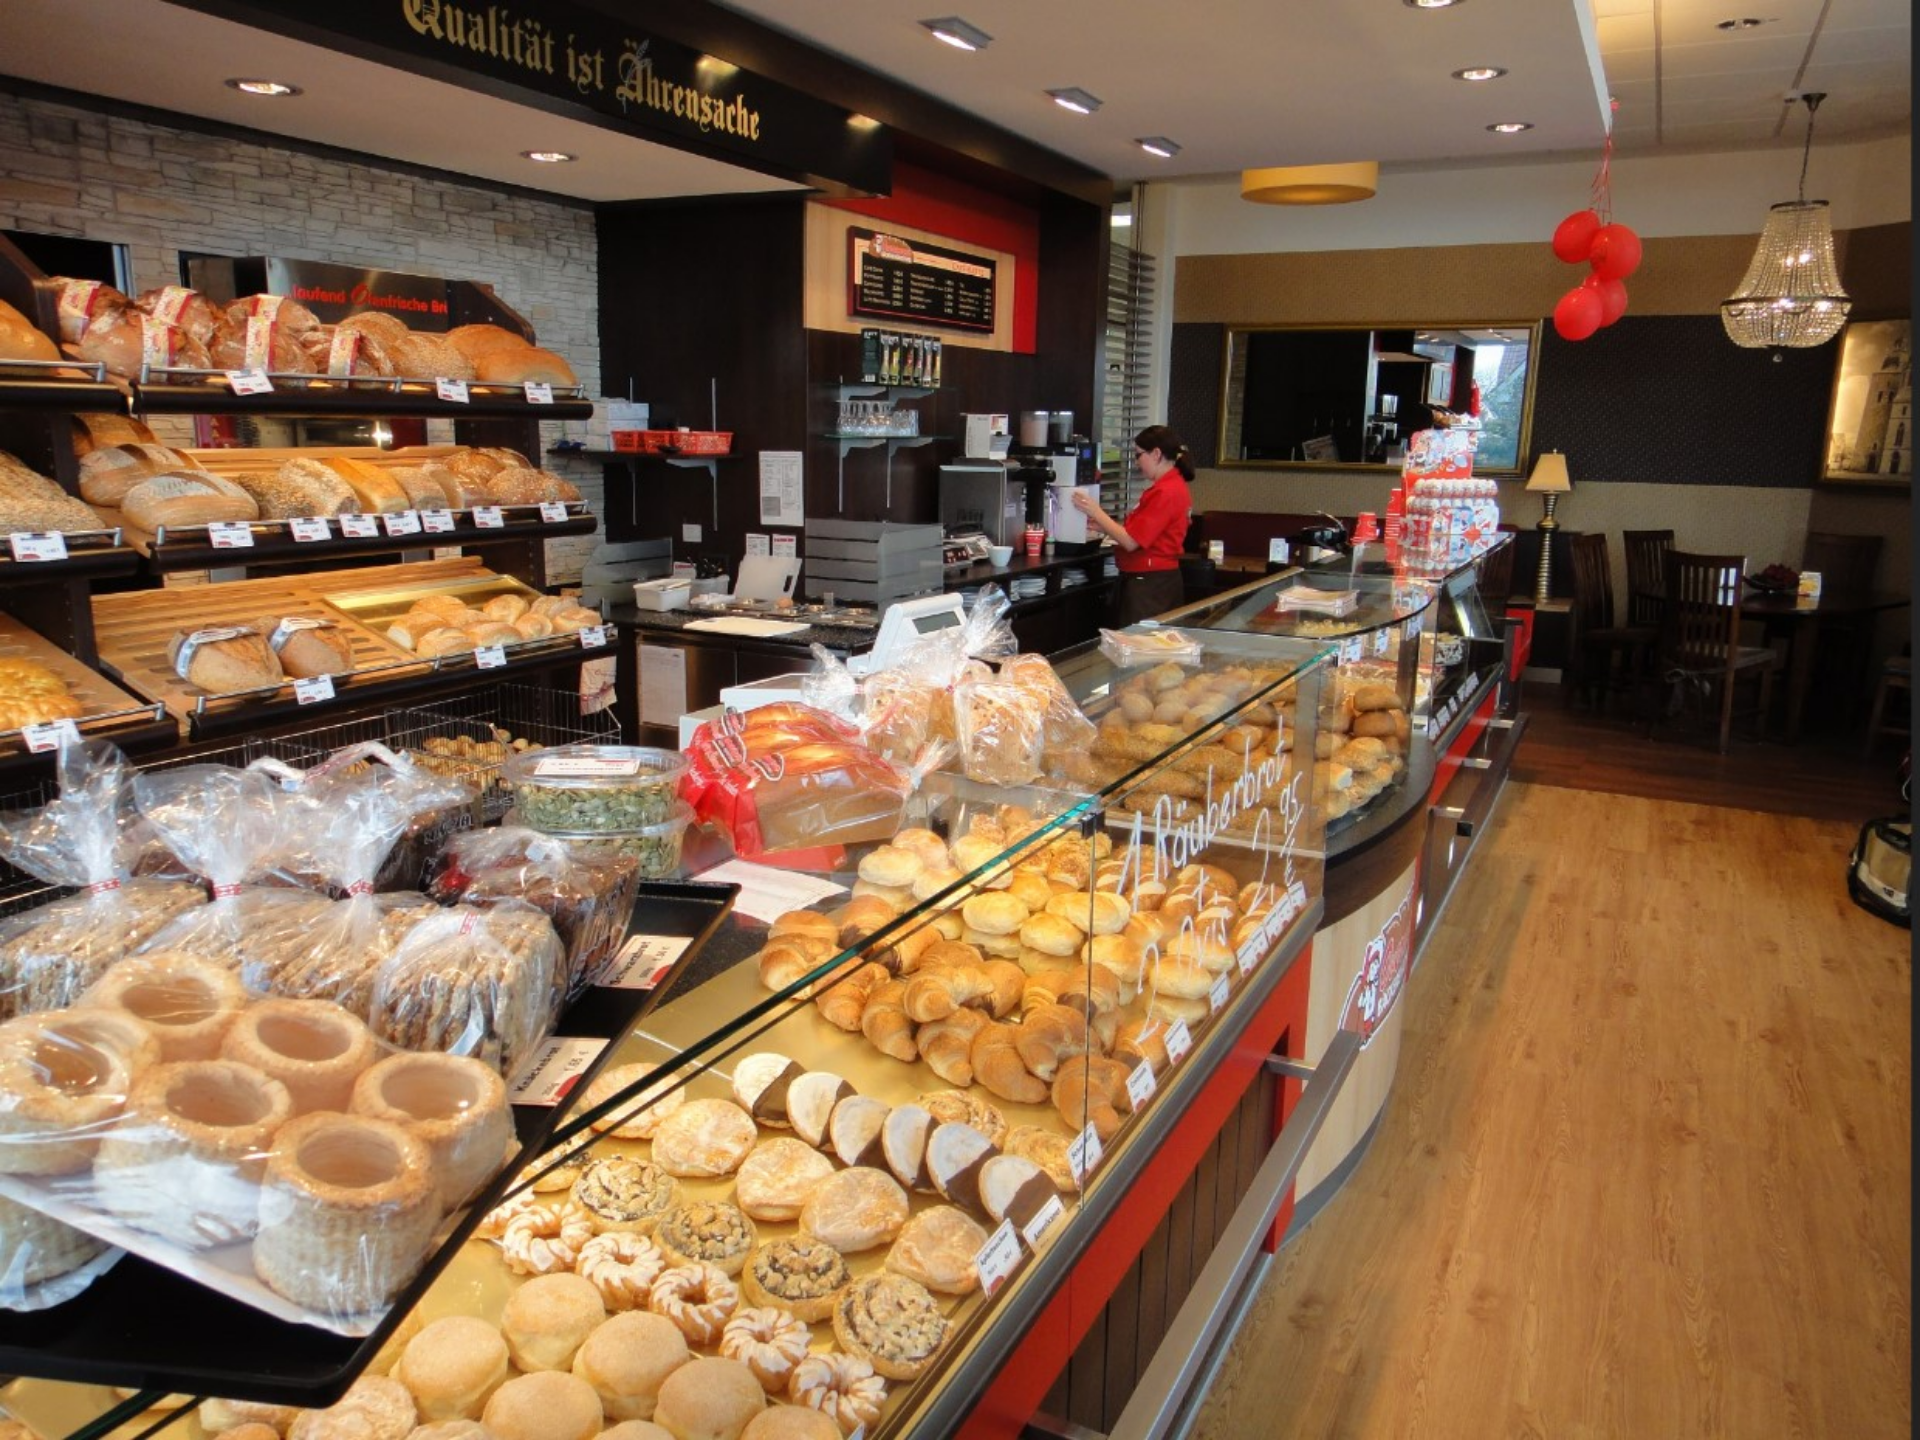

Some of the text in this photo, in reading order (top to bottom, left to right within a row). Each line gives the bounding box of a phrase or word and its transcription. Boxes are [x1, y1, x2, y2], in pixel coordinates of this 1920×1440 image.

[402, 0, 761, 142] Qualität ist Ährensache
[1152, 714, 1287, 883] Räuberbrot
